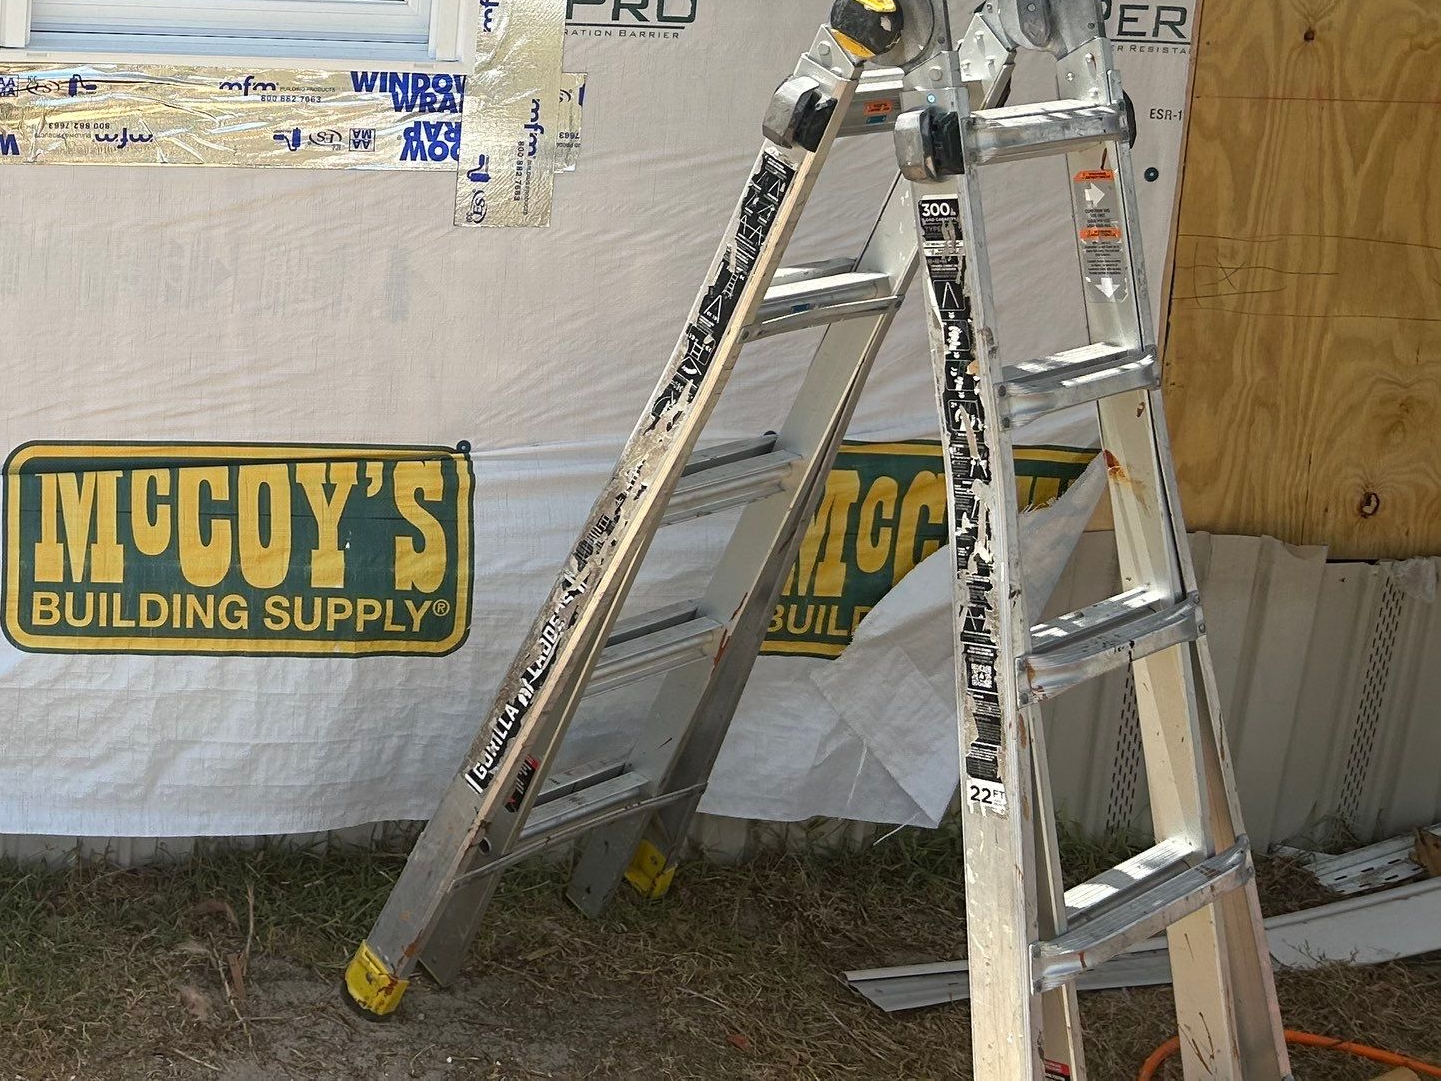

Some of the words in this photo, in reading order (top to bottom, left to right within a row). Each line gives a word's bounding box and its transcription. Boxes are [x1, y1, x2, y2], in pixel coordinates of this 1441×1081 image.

[618, 28, 680, 40] BARRIER
[219, 75, 278, 96] mfm
[1149, 108, 1183, 122] ESR-1
[48, 122, 110, 130] 800.882.7663
[352, 129, 372, 139] MA
[524, 98, 545, 157] mfm
[92, 127, 154, 149] mfm
[352, 139, 371, 151] AA
[921, 202, 950, 218] 300
[33, 460, 447, 594] McCOY'S
[30, 591, 249, 630] BUILDING
[528, 588, 575, 683] LADDES
[472, 703, 519, 781] GORILLA
[970, 785, 993, 805] 22
